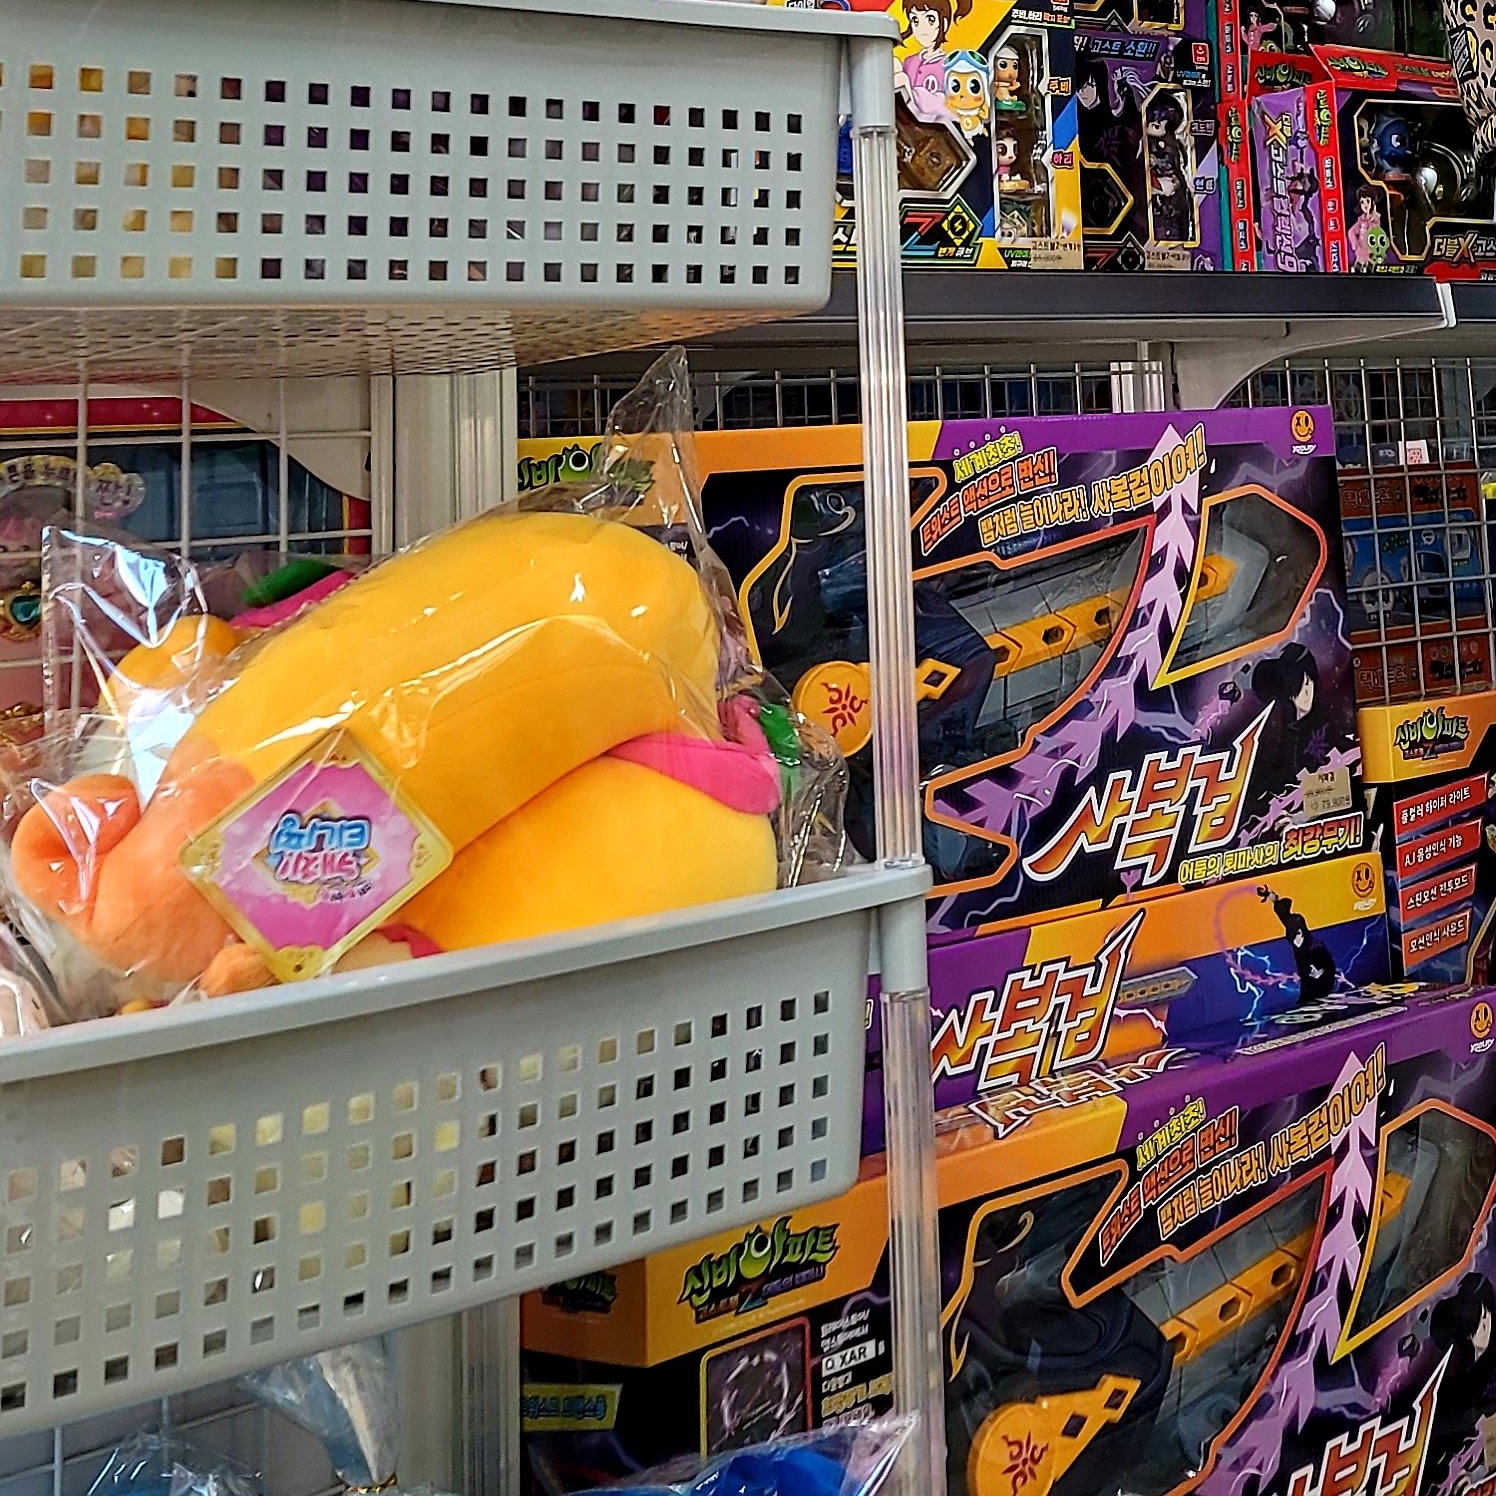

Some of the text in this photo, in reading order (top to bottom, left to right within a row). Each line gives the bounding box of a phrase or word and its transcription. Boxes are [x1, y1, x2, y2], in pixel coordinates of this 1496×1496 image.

[1053, 152, 1073, 165] 하리
[955, 431, 1023, 481] 세계최초!
[979, 422, 1206, 547] 뱀처럼 늘어나라! 사복검이여!
[920, 447, 1058, 555] 트위스트 액션으로 변신!
[1394, 708, 1470, 751] 신비아파트
[1023, 700, 1276, 886] 사복검
[1425, 795, 1449, 818] 하이퍼
[1451, 786, 1472, 808] 라이트
[1180, 812, 1363, 884] 어둠의 퇴마사의 최강무기!
[1415, 843, 1445, 865] 음성인식
[1447, 838, 1464, 855] 기능
[1408, 919, 1466, 954] 모션인식 사운드
[931, 910, 1146, 1090] 사복검
[1137, 1097, 1206, 1171] 세계최초!
[1160, 1044, 1386, 1240] 뱀처럼 늘어나라! 사복검이여!
[1100, 1107, 1239, 1266] 트위스트 액션으로 변신!
[678, 1216, 840, 1306] 신비아파트
